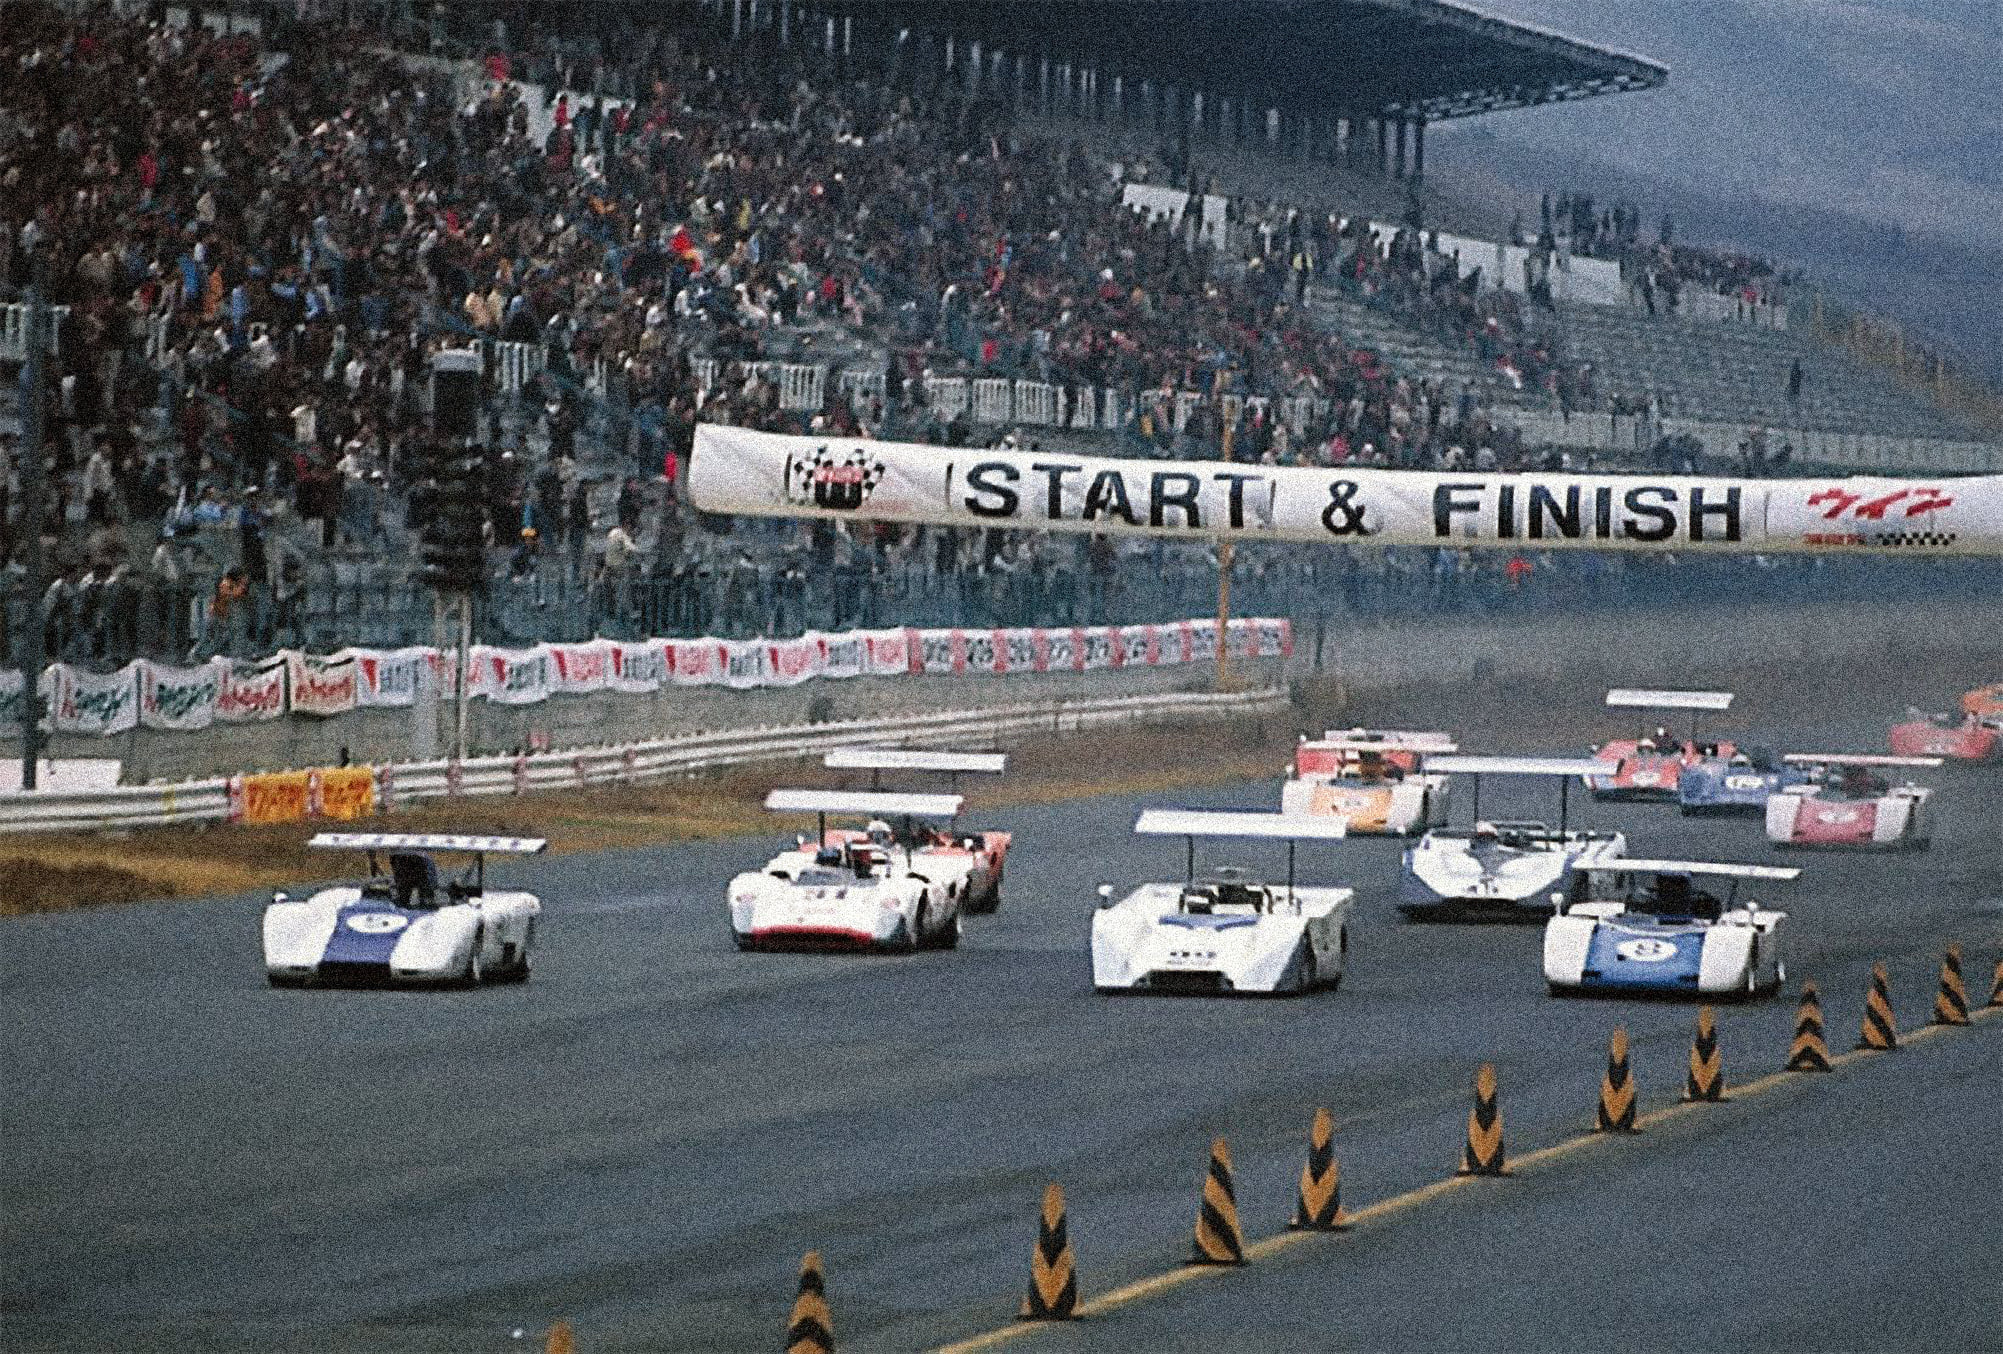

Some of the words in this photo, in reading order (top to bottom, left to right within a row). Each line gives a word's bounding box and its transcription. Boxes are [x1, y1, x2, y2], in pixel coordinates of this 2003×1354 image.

[964, 461, 1264, 530] START
[1320, 480, 1377, 537] &
[1432, 483, 1743, 543] FINISH
